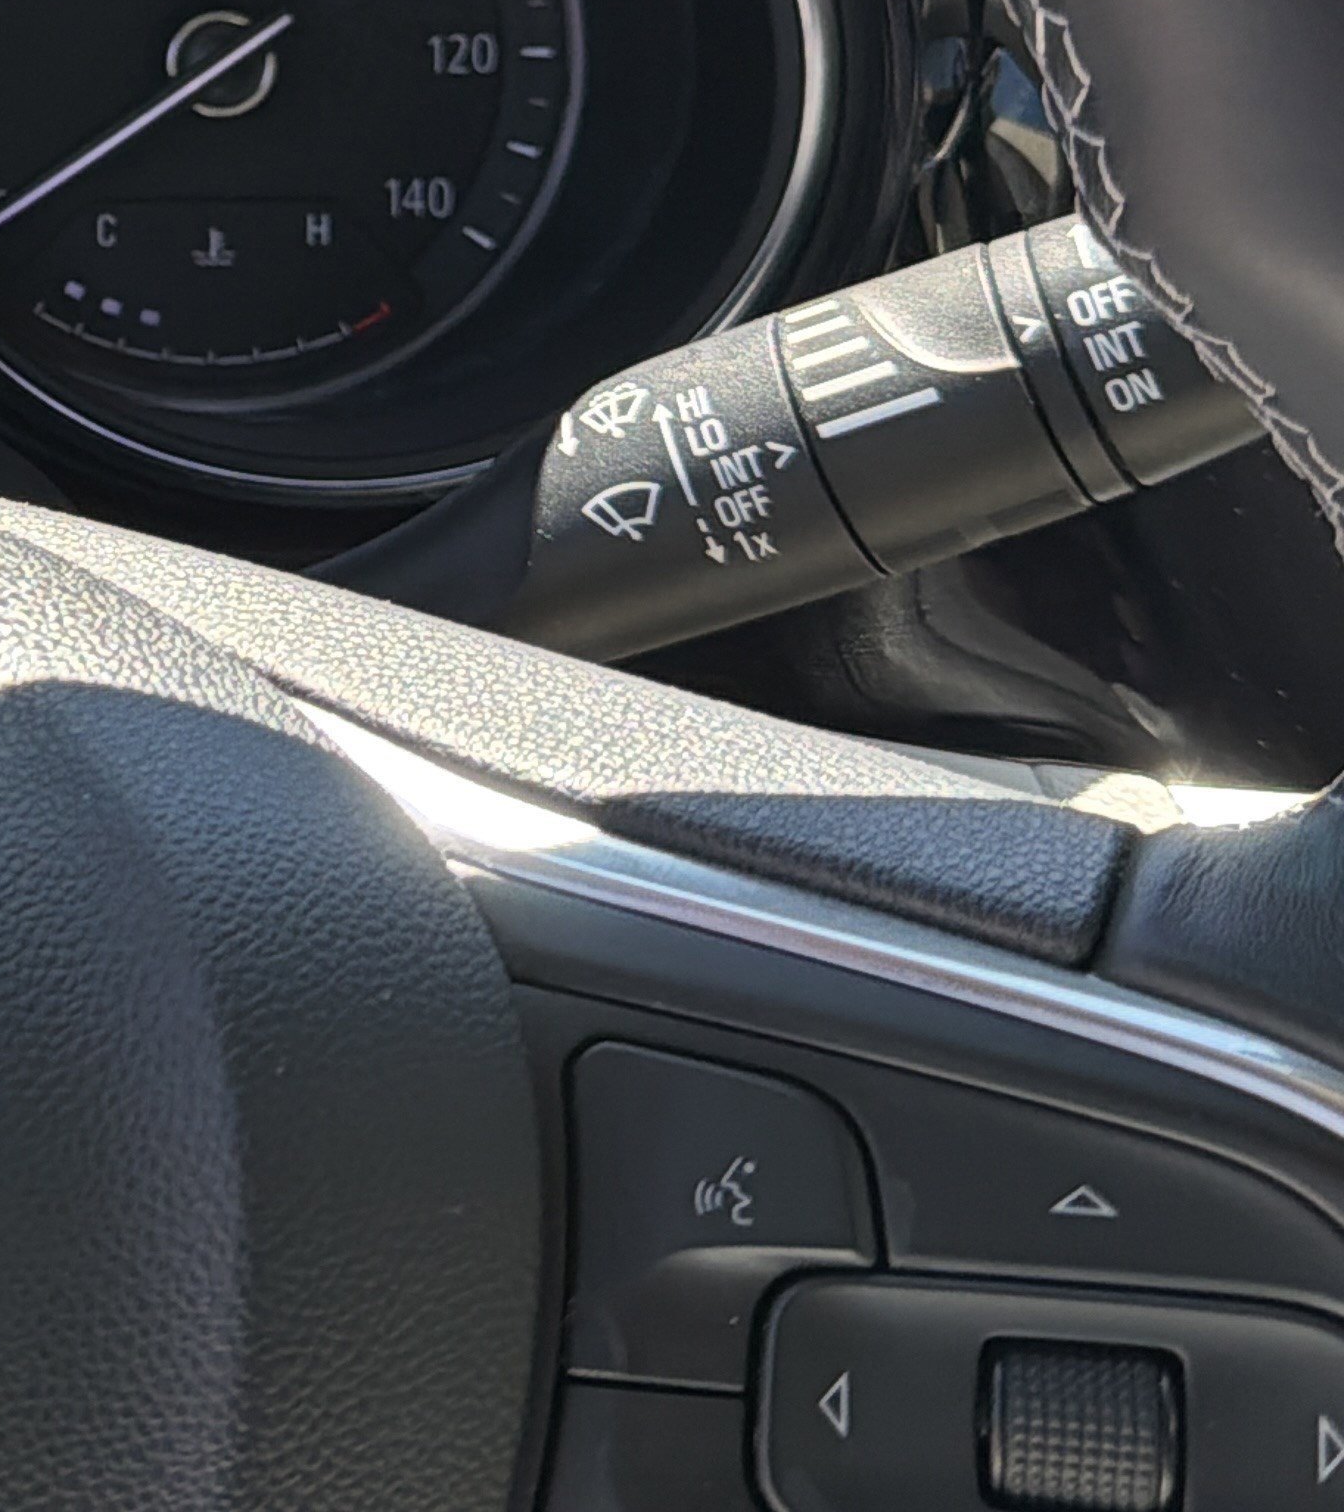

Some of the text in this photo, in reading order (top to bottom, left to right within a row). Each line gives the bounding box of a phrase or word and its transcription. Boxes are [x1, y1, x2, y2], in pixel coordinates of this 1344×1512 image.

[428, 33, 499, 76] 120
[386, 176, 455, 219] 140
[96, 214, 118, 246] C
[306, 214, 331, 246] H
[1067, 276, 1139, 328] OFF
[1083, 322, 1148, 373] INT
[676, 386, 712, 423] HI
[1104, 368, 1165, 413] ON
[685, 418, 729, 458] LO
[711, 446, 766, 490] INT
[714, 485, 774, 529] OFF
